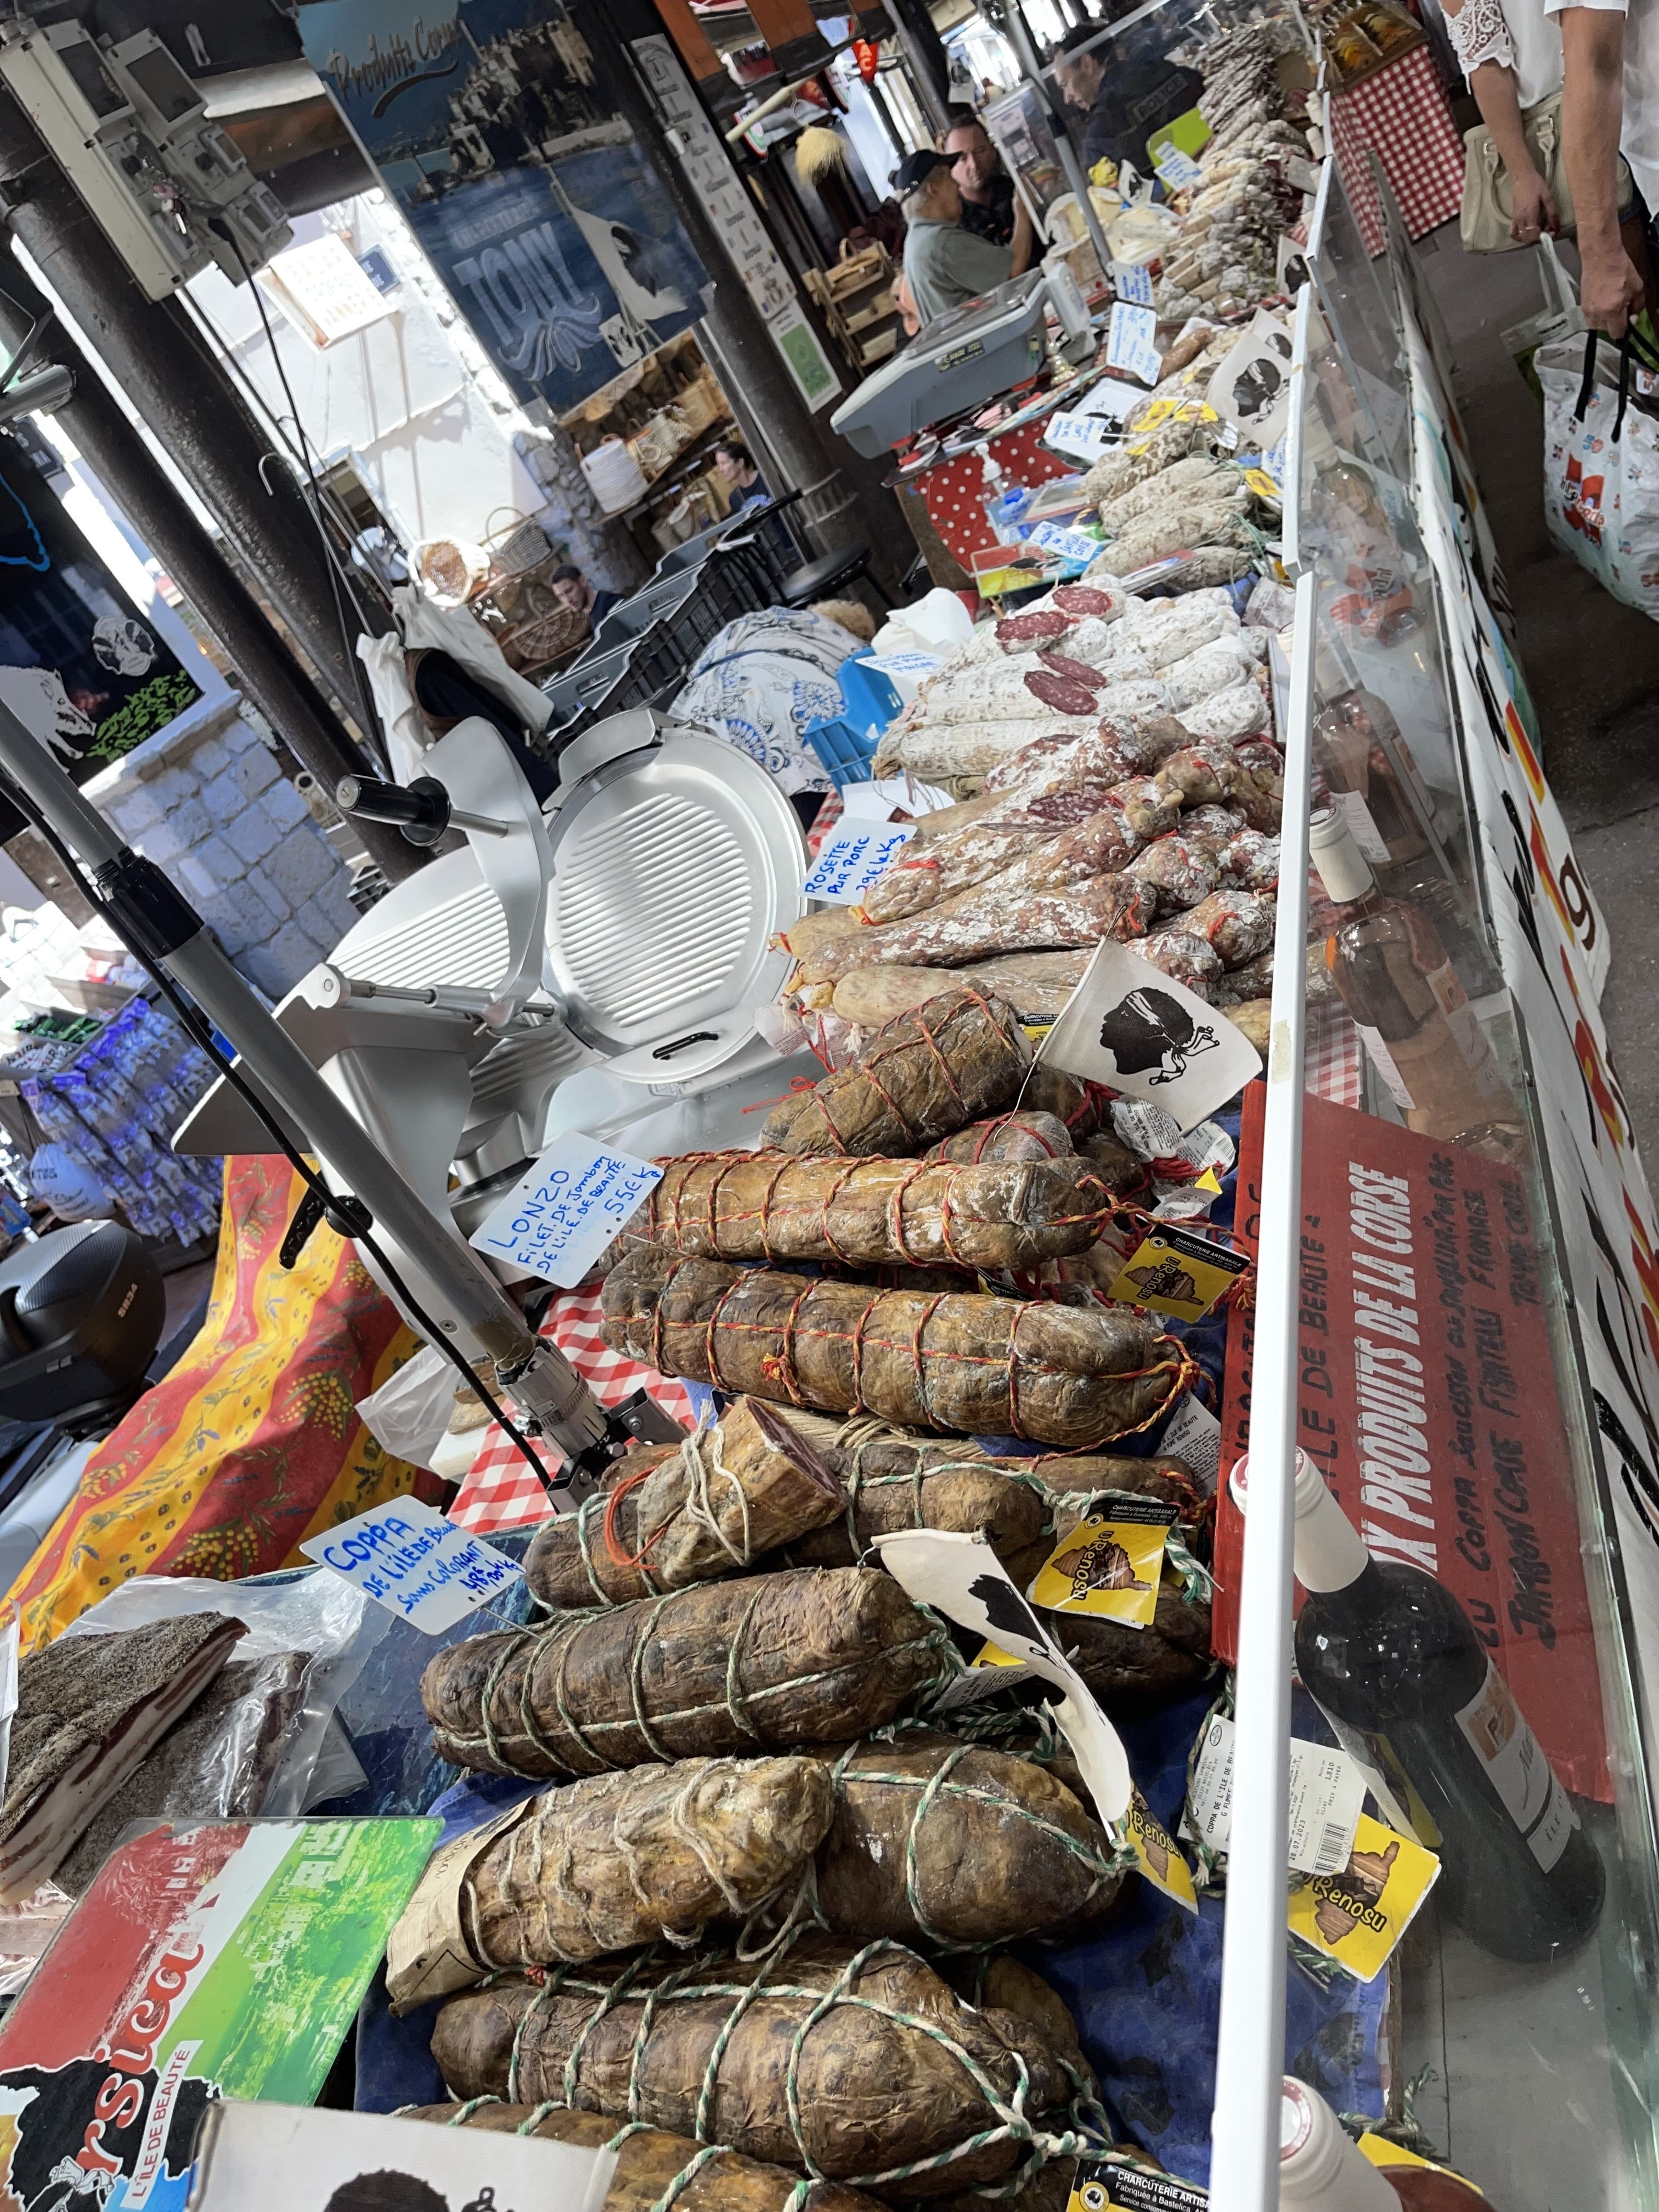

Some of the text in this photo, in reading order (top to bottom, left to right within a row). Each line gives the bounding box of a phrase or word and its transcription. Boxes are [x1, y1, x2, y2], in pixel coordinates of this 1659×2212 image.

[452, 221, 585, 347] TONY
[804, 840, 850, 893] ROSETTE
[827, 836, 870, 895] PUR PORC
[488, 1170, 570, 1249] LONZO
[551, 1204, 572, 1223] DE
[1348, 1160, 1414, 1255] CORSE
[537, 1251, 558, 1274] DE
[577, 1199, 595, 1215] DE
[1175, 1237, 1211, 1255] CHARCUTERIE
[1210, 1251, 1242, 1268] ARTISANALE
[1351, 1251, 1417, 1300] LA
[1353, 1288, 1420, 1346] DE
[1301, 1346, 1334, 1399] DE
[1354, 1336, 1435, 1530] PRODUITS
[1112, 1504, 1177, 1515] CHARCUTERIE ARTISANALE
[324, 1516, 416, 1572] COPPA
[362, 1572, 391, 1599] DE
[1216, 1778, 1228, 1799] L'ILE
[1224, 1766, 1232, 1776] DE
[1328, 1791, 1336, 1807] PRIX
[1333, 1765, 1342, 1784] PAYER
[1206, 1812, 1218, 1833] COPPA
[1214, 1801, 1222, 1811] DE
[1289, 1819, 1306, 1861] 28.07.2023
[1313, 1875, 1386, 1931] Renosu
[153, 2049, 191, 2121] BEAUTÉ
[147, 2123, 163, 2151] DE
[1115, 2182, 1151, 2200] Fabriquée
[1117, 2171, 1179, 2199] CHARCUTERIE
[1119, 2194, 1140, 2207] Service
